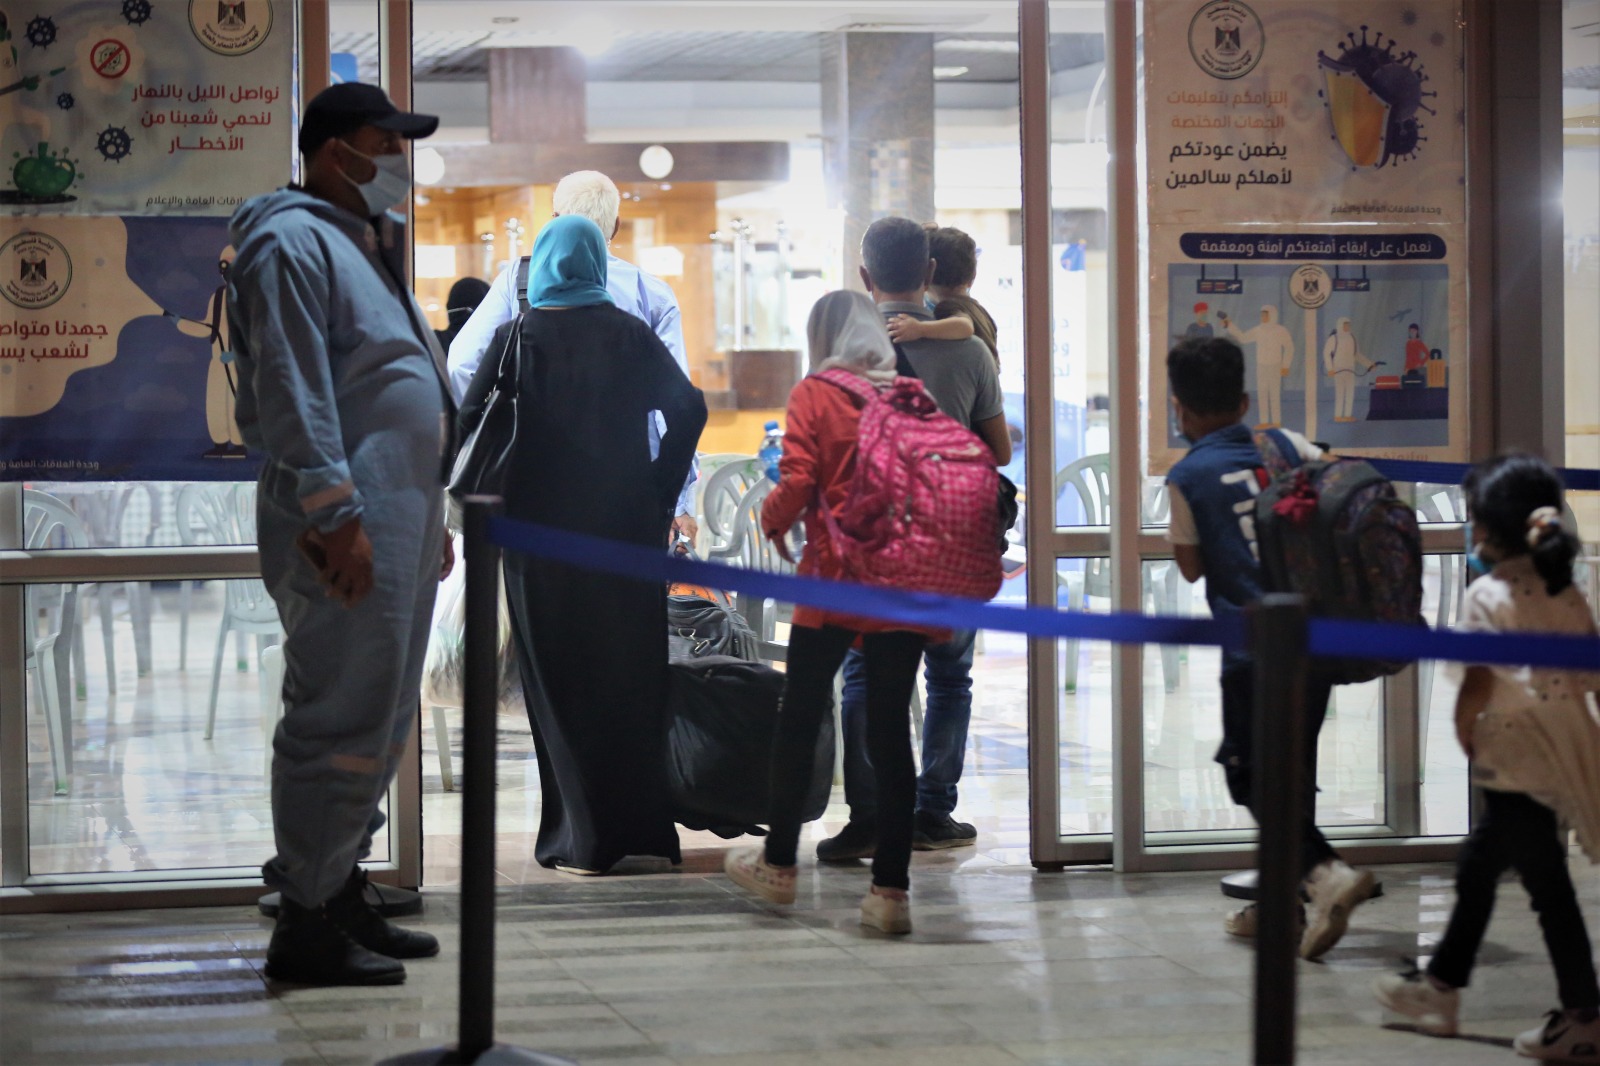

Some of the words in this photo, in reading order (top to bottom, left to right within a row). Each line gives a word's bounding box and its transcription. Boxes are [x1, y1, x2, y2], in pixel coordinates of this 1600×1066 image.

[131, 84, 183, 102] بالنهار
[187, 85, 225, 103] الليل
[230, 85, 279, 104] نواصل
[1166, 90, 1229, 108] بتعليمات
[141, 110, 165, 128] من
[170, 108, 218, 128] شعبنا
[222, 111, 271, 132] لنحمي
[1171, 115, 1231, 129] المختصة
[1234, 115, 1285, 131] الجهات
[1170, 141, 1234, 163] عودتكم
[1238, 141, 1287, 161] يضمن
[1166, 169, 1231, 189] سالمين
[1236, 167, 1292, 190] لأهلكم
[185, 195, 215, 206] العامة
[1200, 240, 1255, 257] ومعقمة
[1257, 239, 1283, 254] آمنة
[1284, 239, 1336, 258] أمتعتكم
[1339, 240, 1368, 258] إبقاء
[1369, 240, 1393, 257] على
[1396, 241, 1432, 257] نعمل
[0, 320, 50, 340] متواص
[55, 320, 108, 339] جهدنا
[31, 340, 89, 362] لشعب
